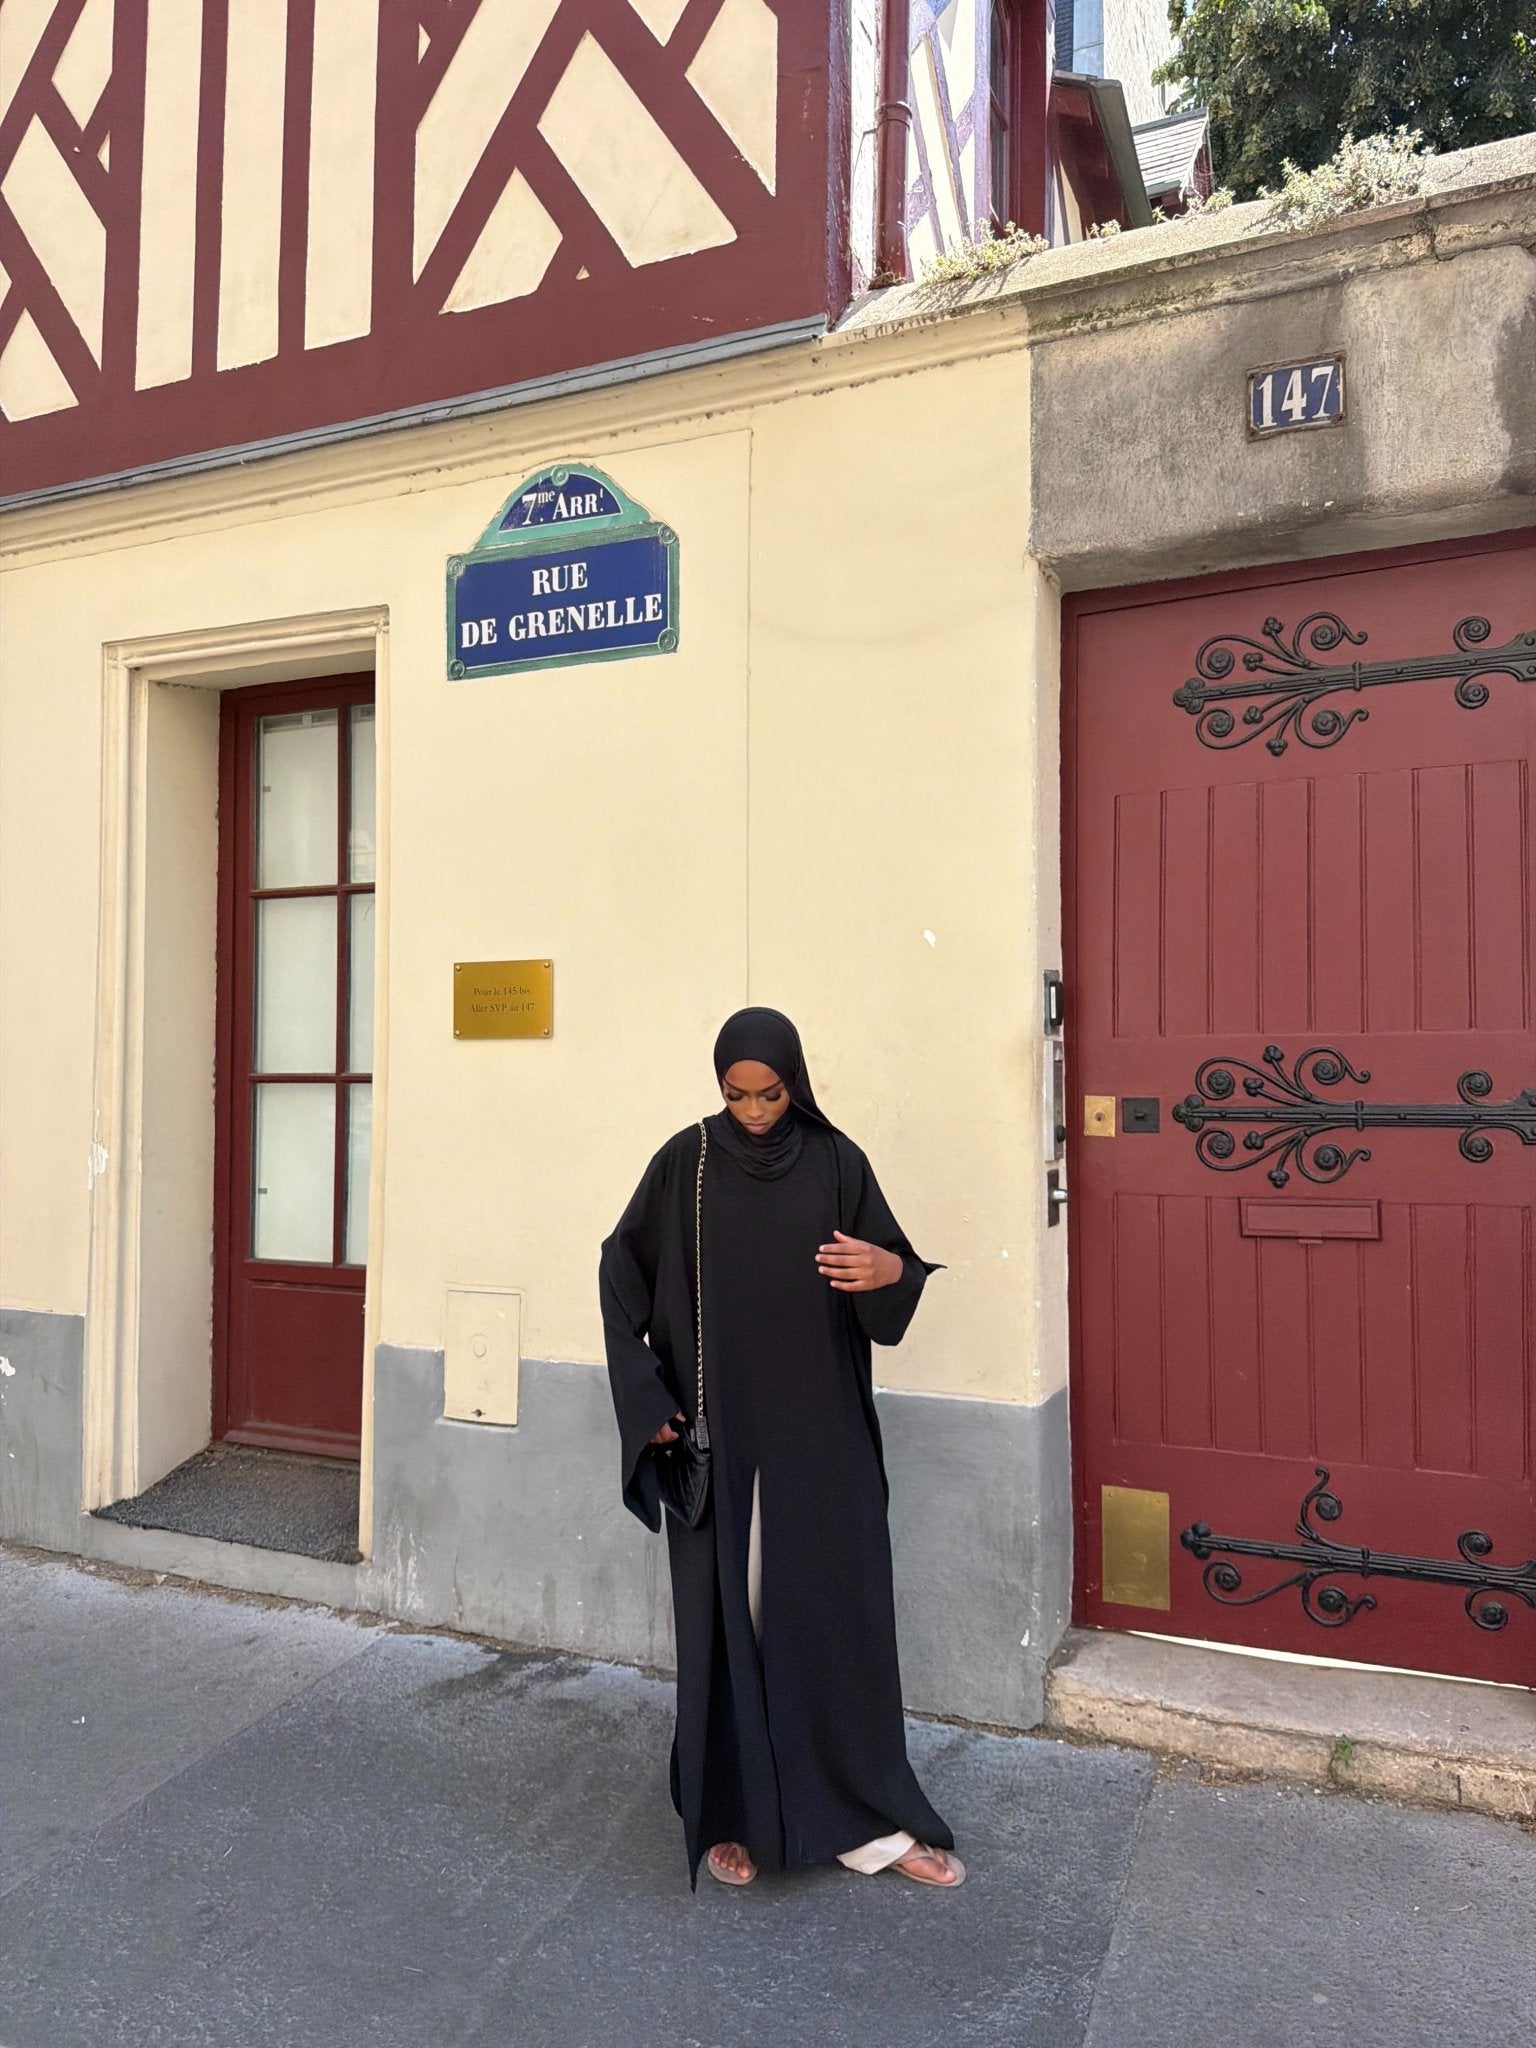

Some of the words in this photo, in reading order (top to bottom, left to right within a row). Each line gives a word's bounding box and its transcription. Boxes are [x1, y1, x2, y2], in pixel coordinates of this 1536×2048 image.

[1256, 366, 1334, 428] 147
[532, 562, 588, 596] RUE
[461, 618, 497, 648] DE
[508, 593, 663, 641] GRENELLE
[489, 1003, 507, 1012] SVP
[521, 1002, 535, 1011] 147
[503, 986, 517, 995] 145
